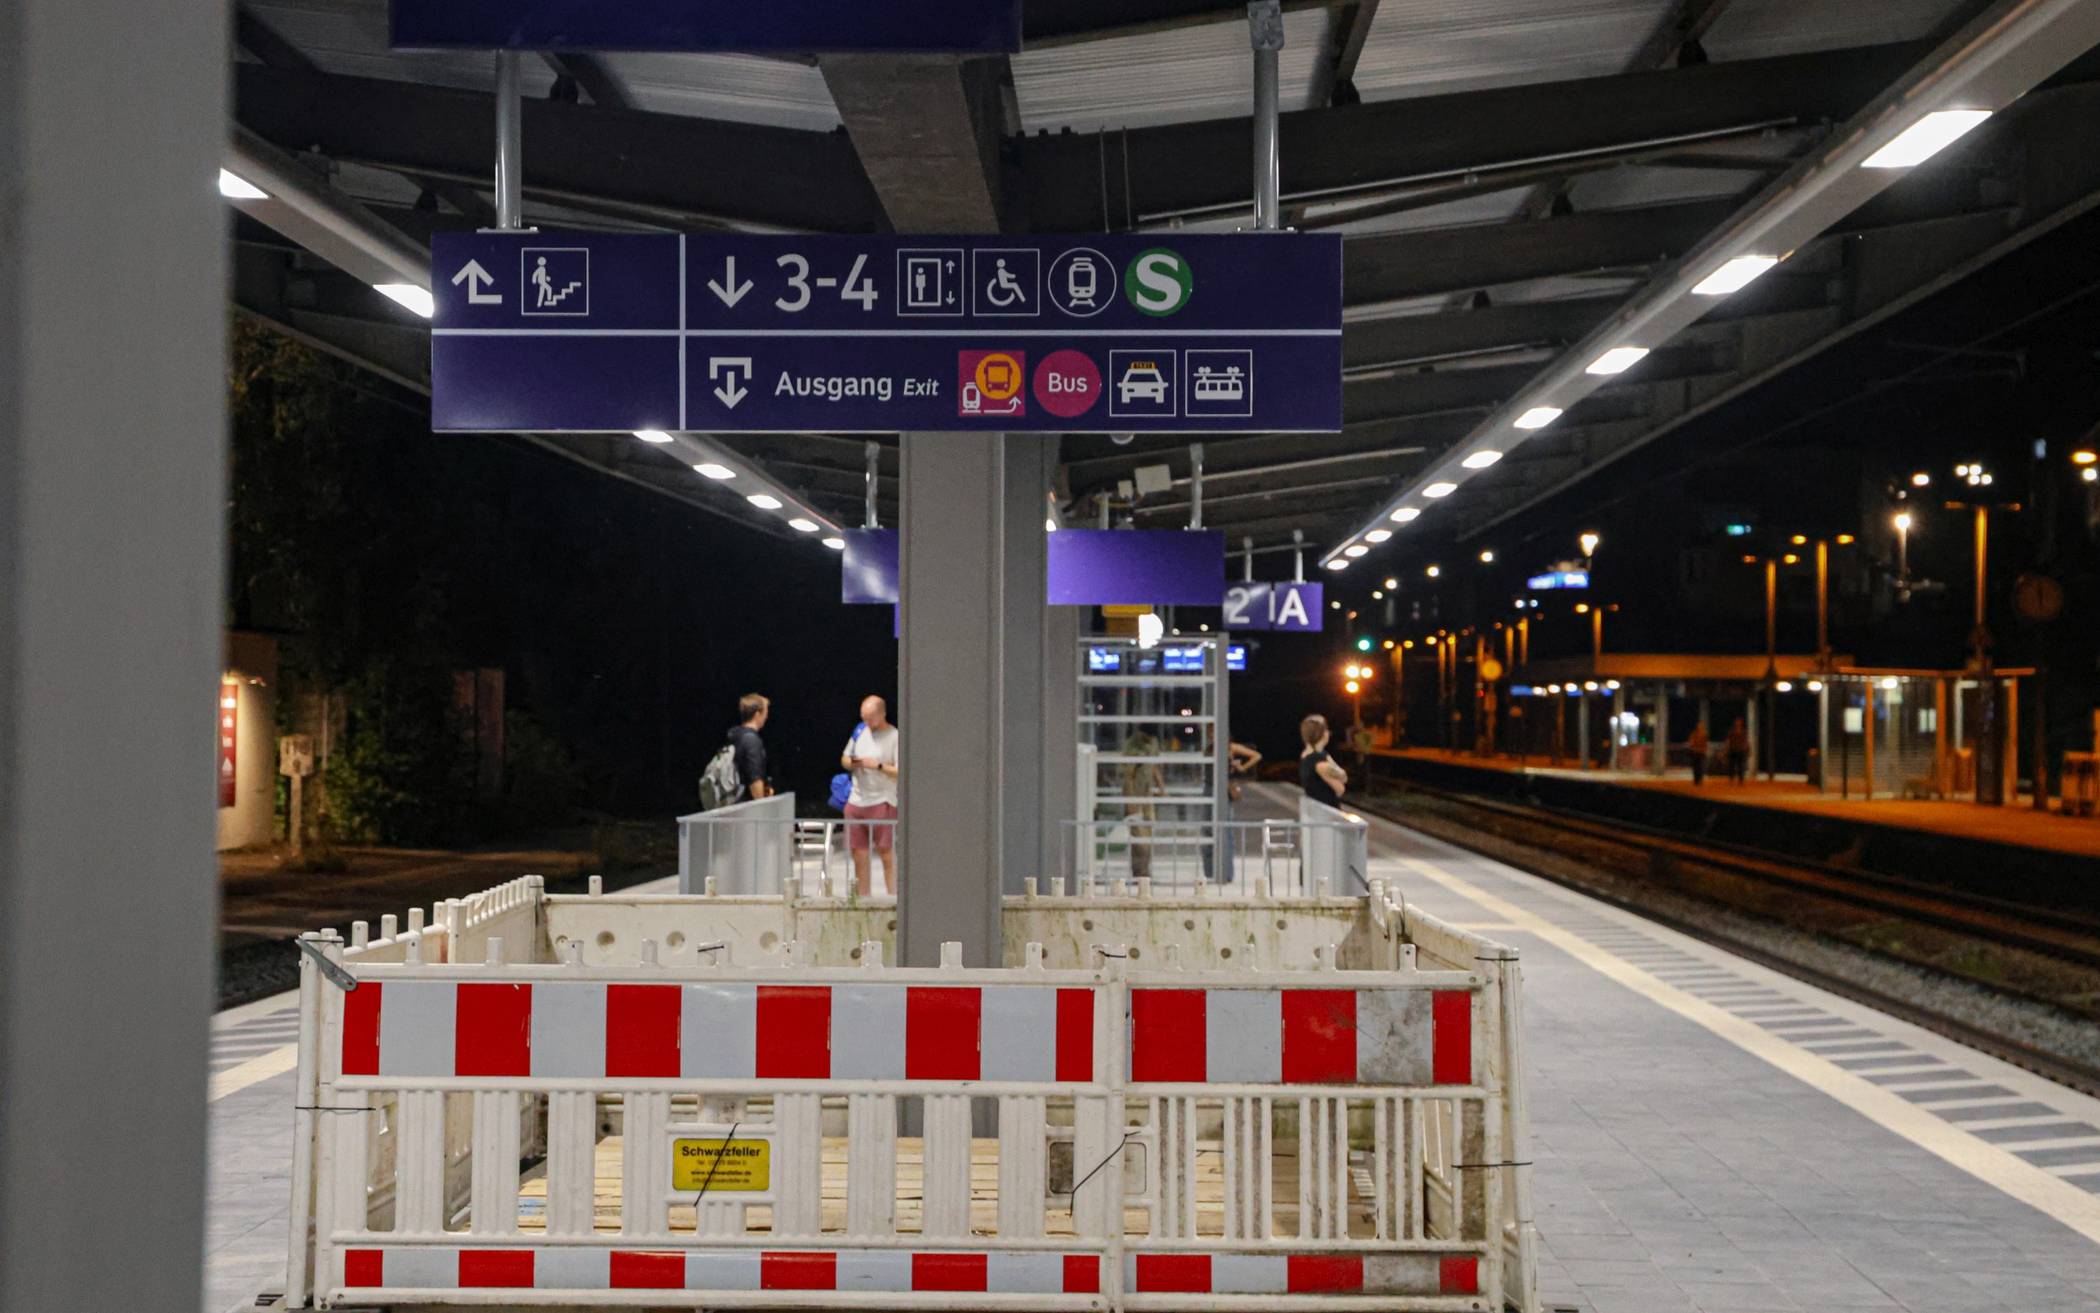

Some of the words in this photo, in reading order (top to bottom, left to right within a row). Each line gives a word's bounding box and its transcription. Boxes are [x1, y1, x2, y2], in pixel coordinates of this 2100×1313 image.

[776, 253, 878, 312] 3-4
[1136, 254, 1181, 311] S
[775, 371, 892, 401] Ausgang
[904, 379, 940, 396] Exit
[1048, 372, 1088, 393] Bus
[1226, 588, 1251, 624] 2
[1277, 588, 1309, 625] A
